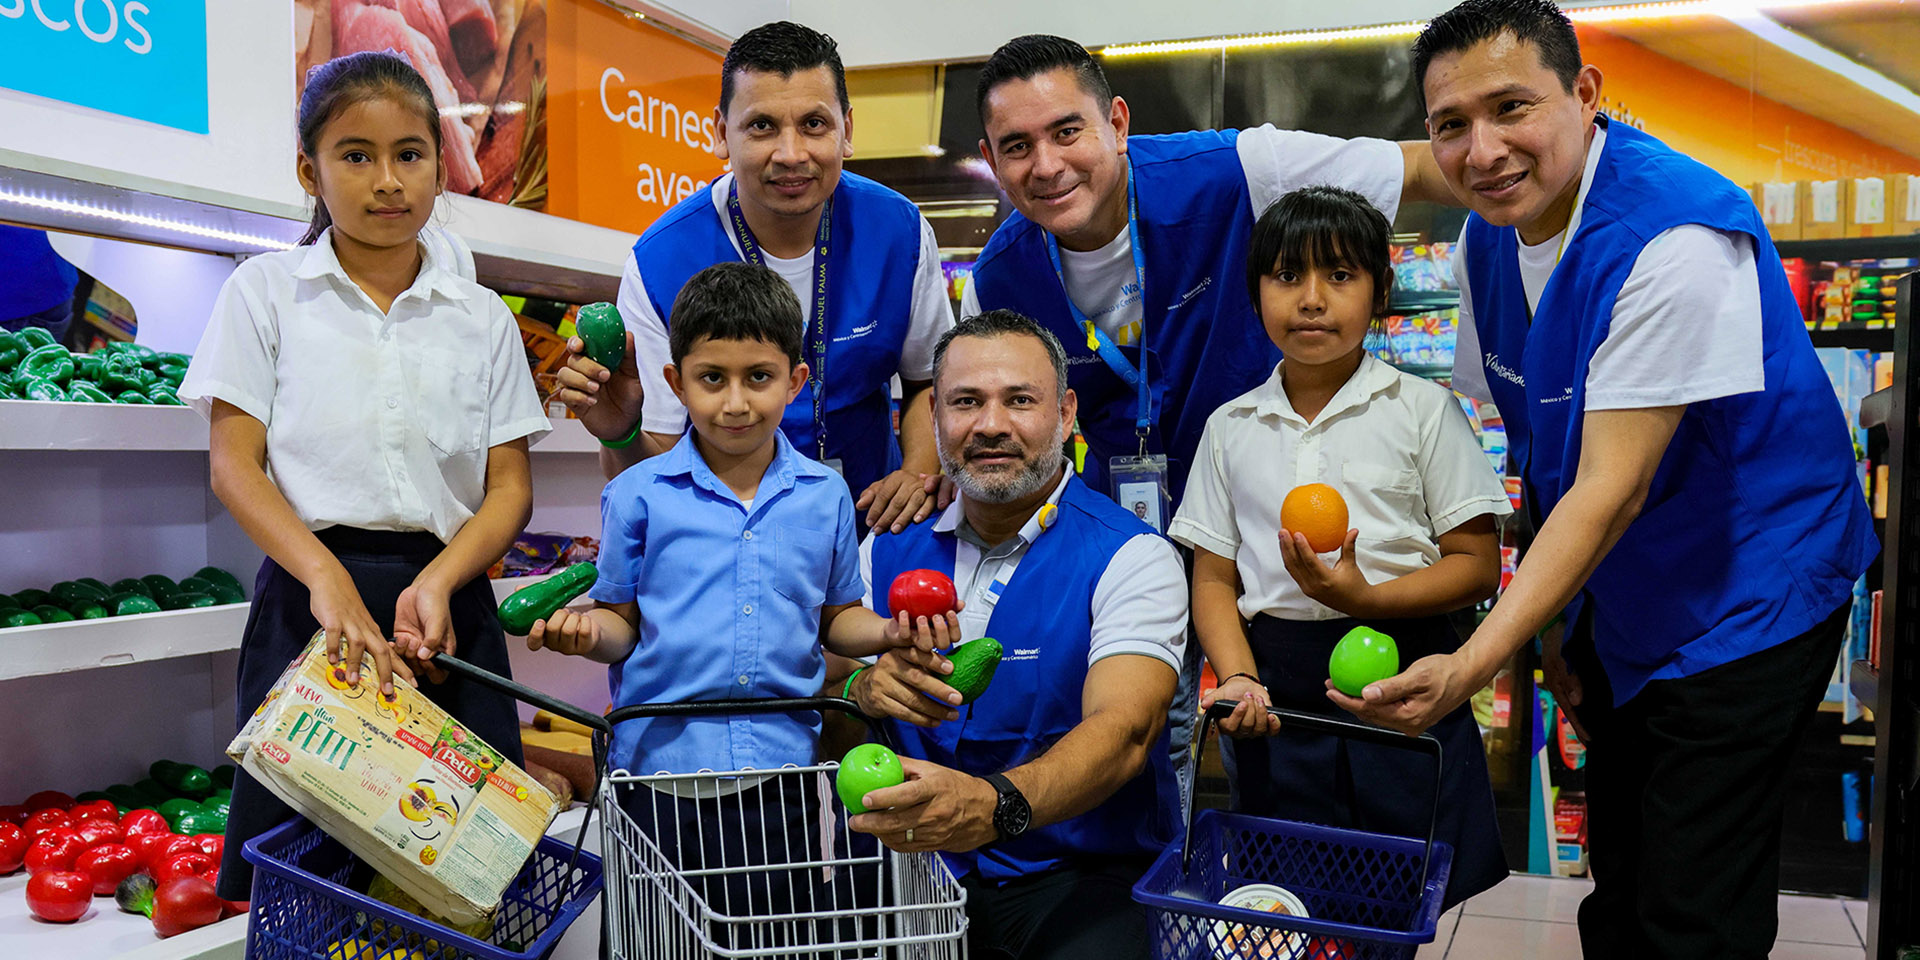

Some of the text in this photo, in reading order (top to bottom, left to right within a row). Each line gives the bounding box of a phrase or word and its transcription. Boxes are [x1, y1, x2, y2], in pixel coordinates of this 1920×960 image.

[599, 67, 714, 154] Carnes
[637, 163, 707, 207] ave
[735, 215, 759, 265] MANUEL PA
[818, 263, 827, 294] PALMA
[295, 682, 323, 704] NUEVO
[263, 743, 287, 761] Petit
[287, 711, 361, 771] PETIT
[441, 749, 475, 780] Petit
